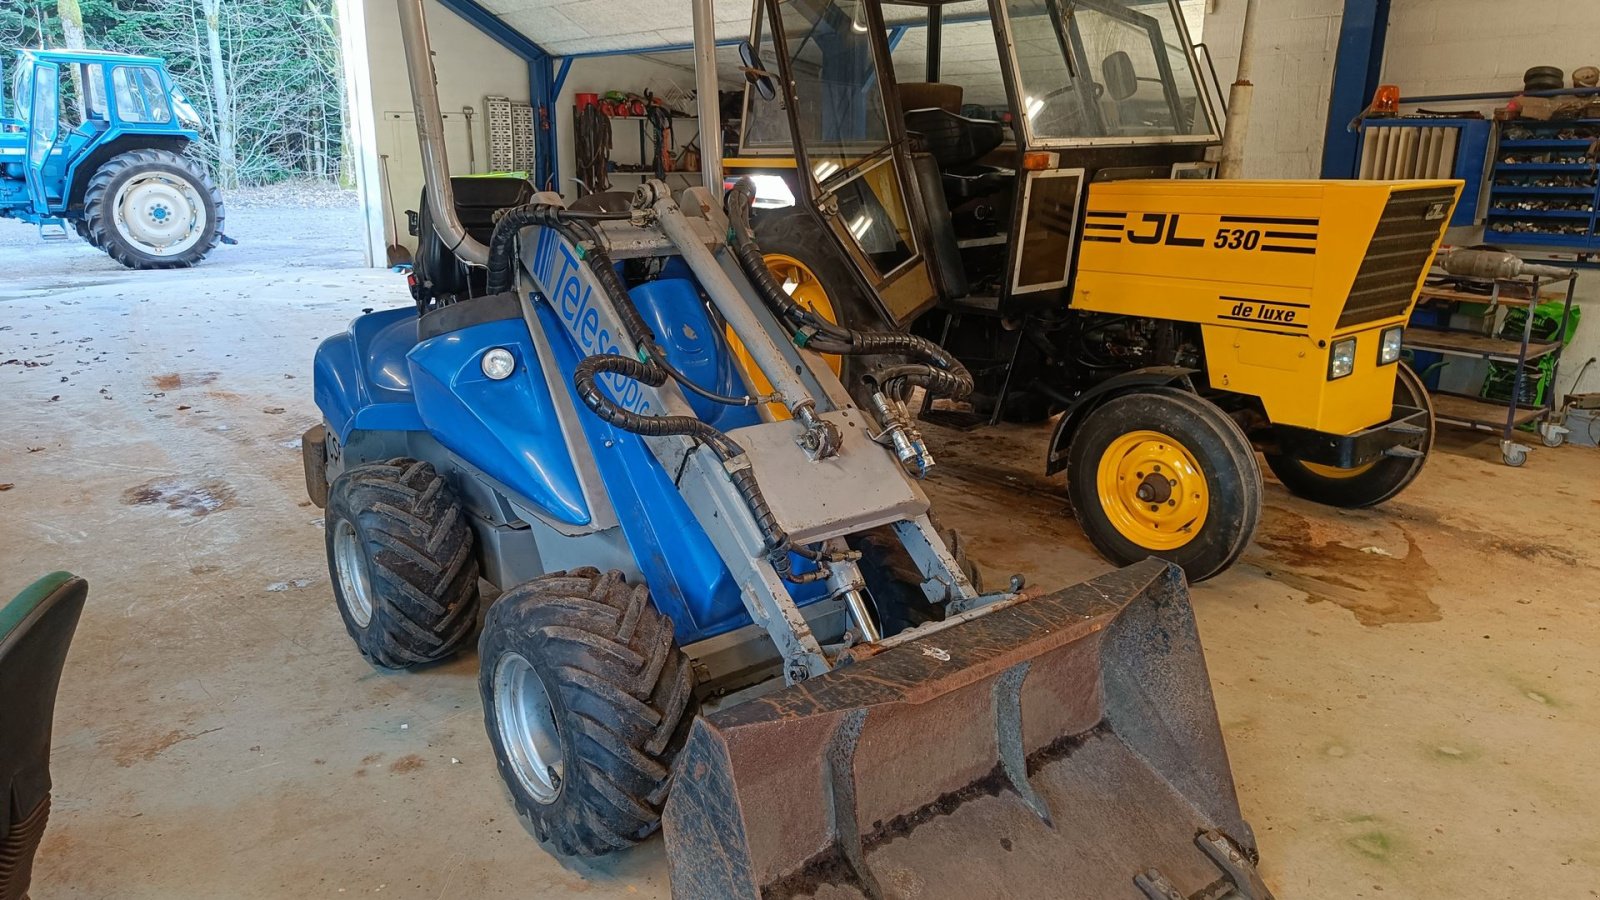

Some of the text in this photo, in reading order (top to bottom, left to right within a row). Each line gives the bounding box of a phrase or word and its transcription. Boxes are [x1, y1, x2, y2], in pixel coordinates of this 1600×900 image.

[1127, 213, 1261, 251] JL 530
[1231, 302, 1296, 322] de luxe
